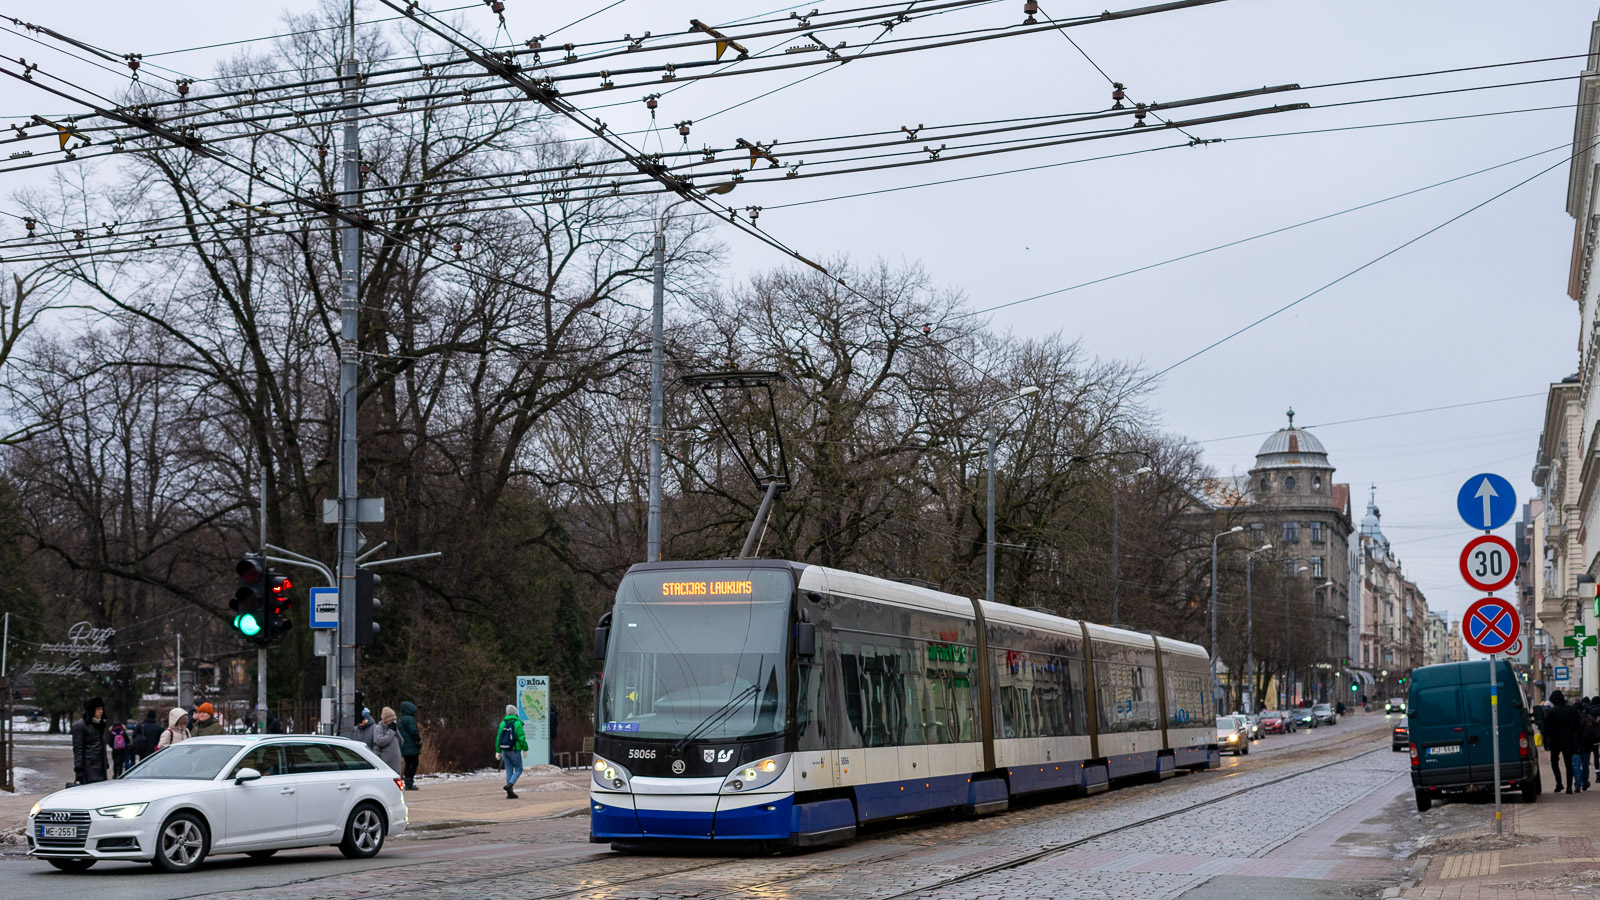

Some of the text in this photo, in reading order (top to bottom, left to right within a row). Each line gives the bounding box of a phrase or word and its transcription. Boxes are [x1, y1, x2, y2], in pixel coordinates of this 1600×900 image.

[1475, 550, 1502, 577] 30
[662, 581, 752, 596] STACIJAS LAUKUMS
[628, 749, 656, 759] 58066
[45, 827, 75, 837] ME-2551
